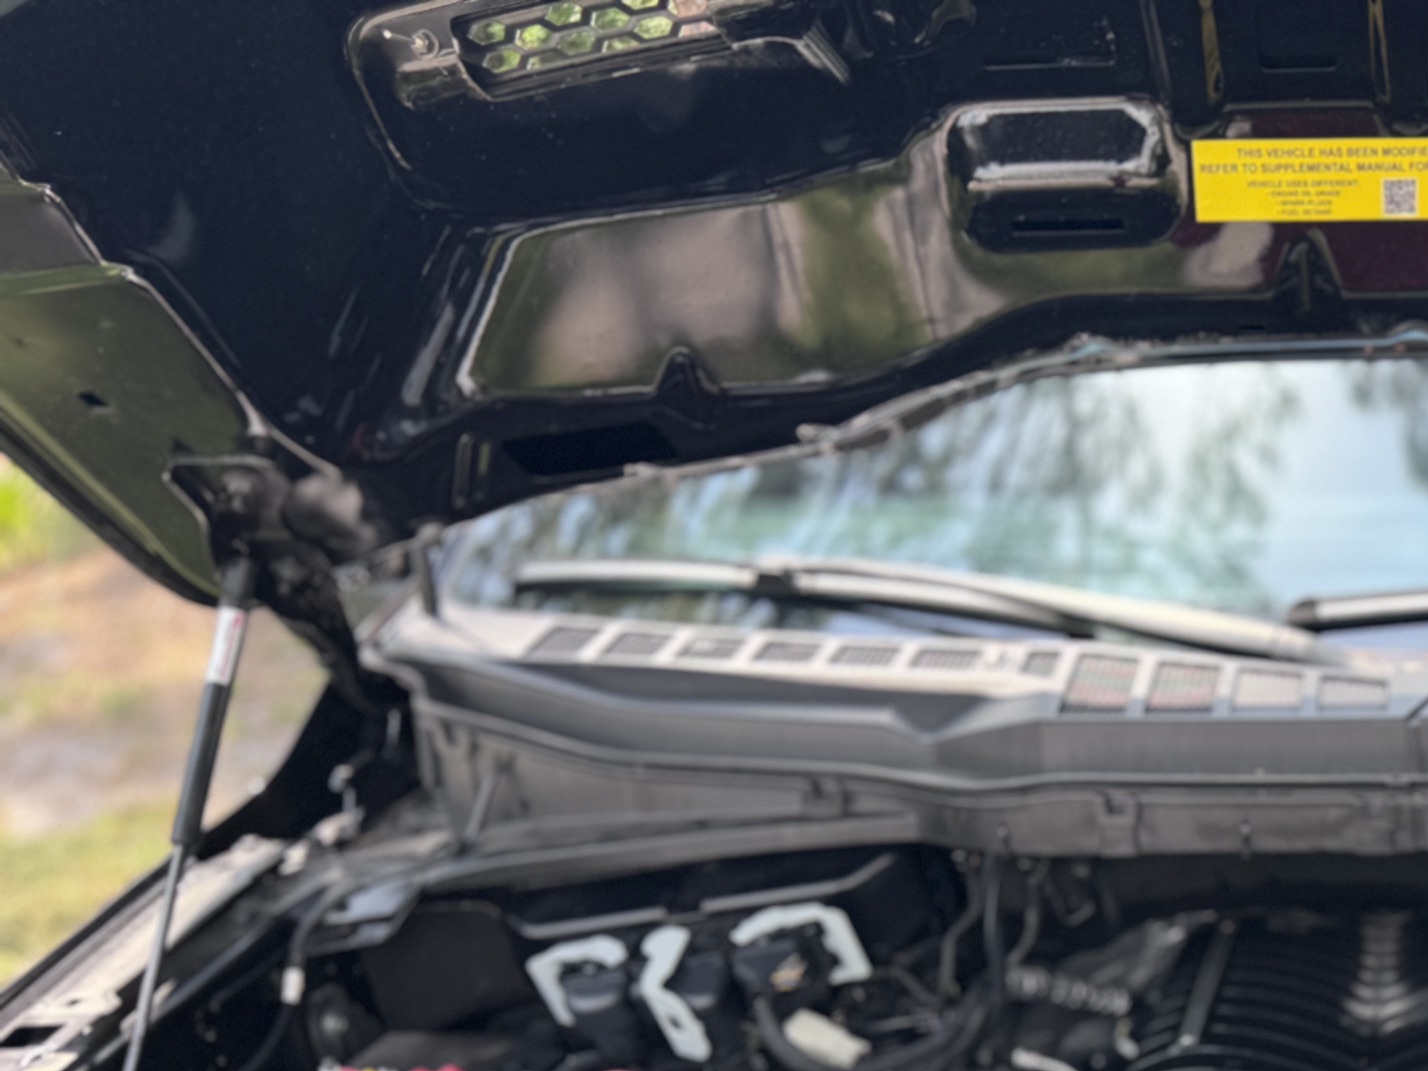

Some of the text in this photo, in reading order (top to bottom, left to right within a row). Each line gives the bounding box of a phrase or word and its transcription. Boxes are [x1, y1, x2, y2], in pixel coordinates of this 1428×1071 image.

[1237, 148, 1261, 158] THIS
[1267, 148, 1315, 158] VEHICLE
[1319, 147, 1342, 157] HAS
[1346, 147, 1377, 157] BEEN
[1200, 163, 1237, 174] REFER
[1242, 163, 1257, 173] TO
[1261, 162, 1352, 173] SUPPLEMENTAL
[1356, 161, 1404, 172] MANUAL
